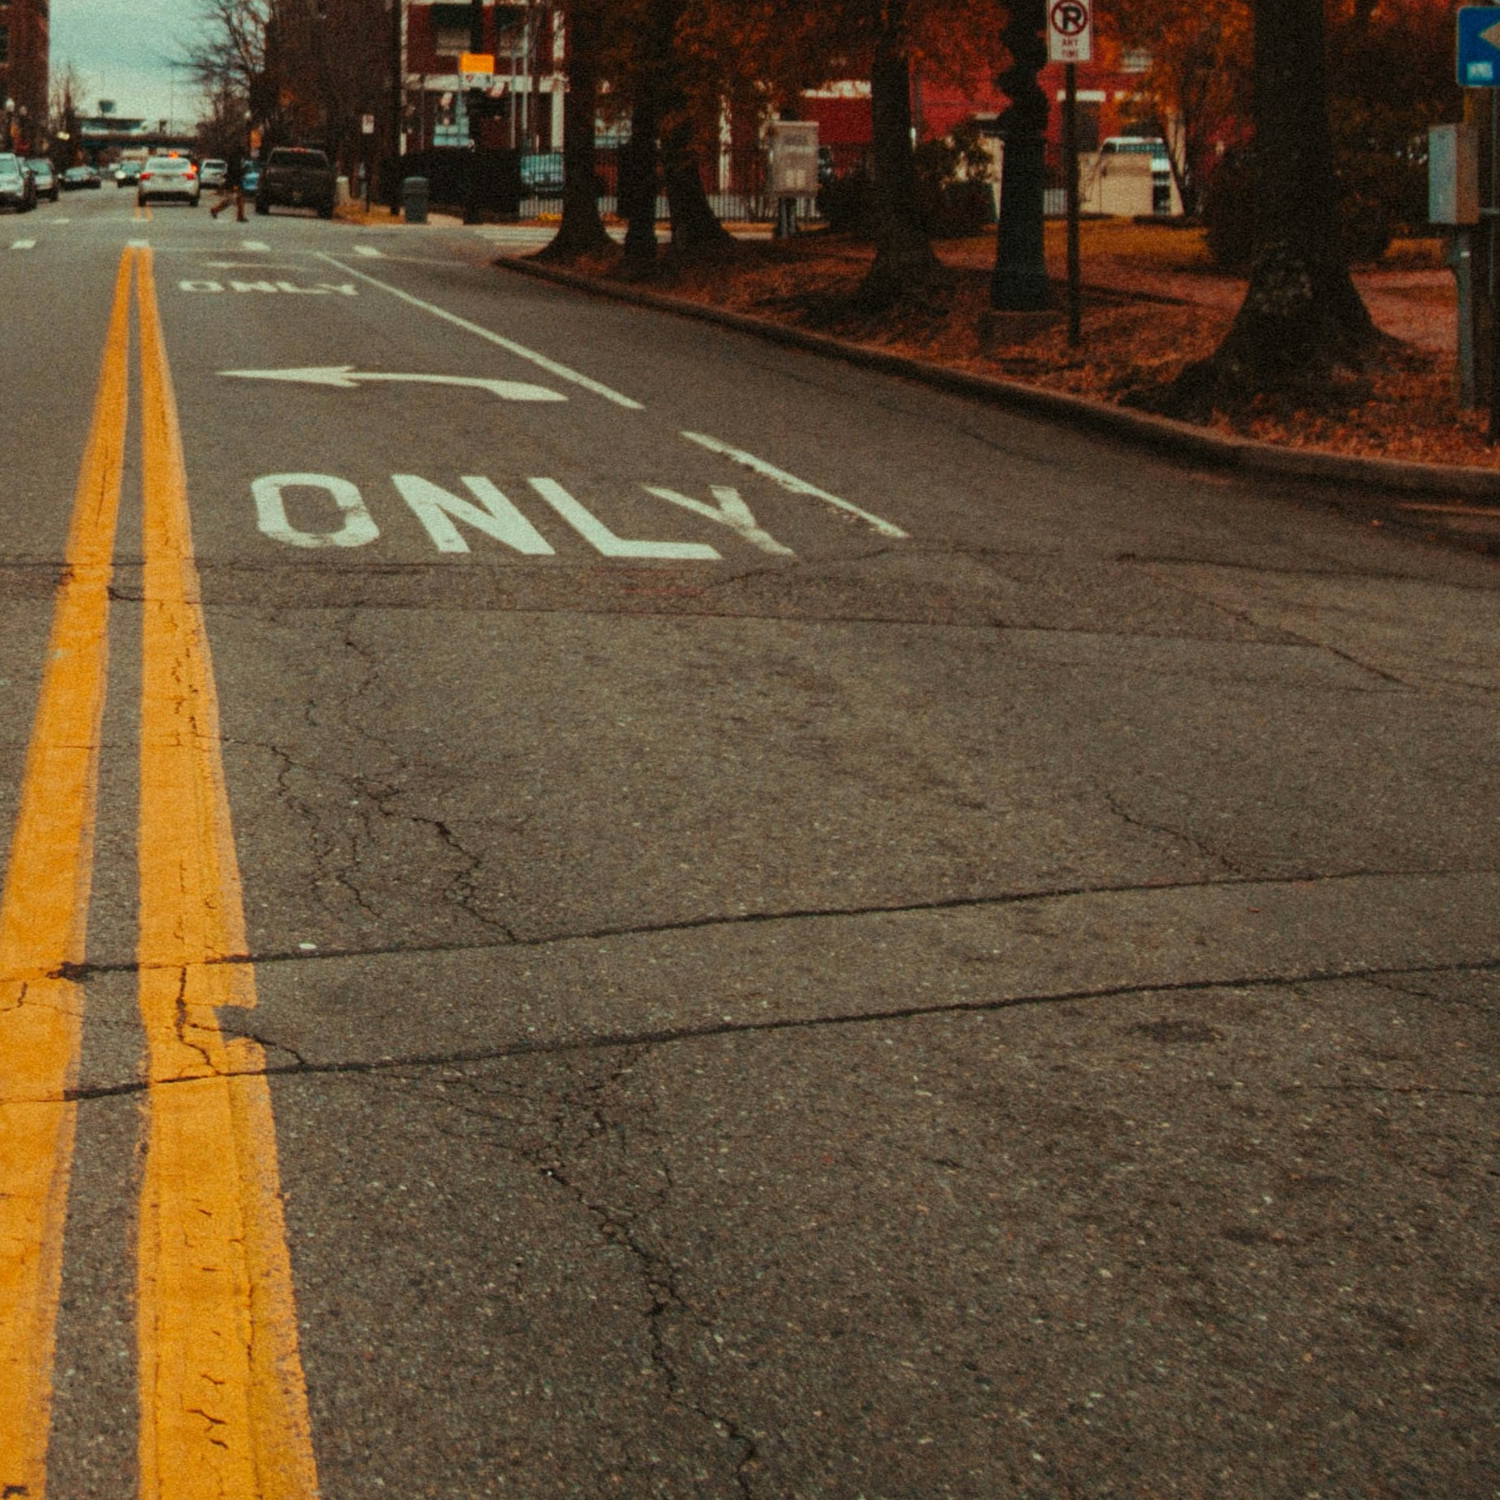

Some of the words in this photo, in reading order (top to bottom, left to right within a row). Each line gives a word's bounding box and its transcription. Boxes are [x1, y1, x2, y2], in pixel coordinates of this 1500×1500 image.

[1061, 37, 1079, 46] ANY
[178, 280, 359, 296] ONLY
[250, 472, 796, 560] ONLY
